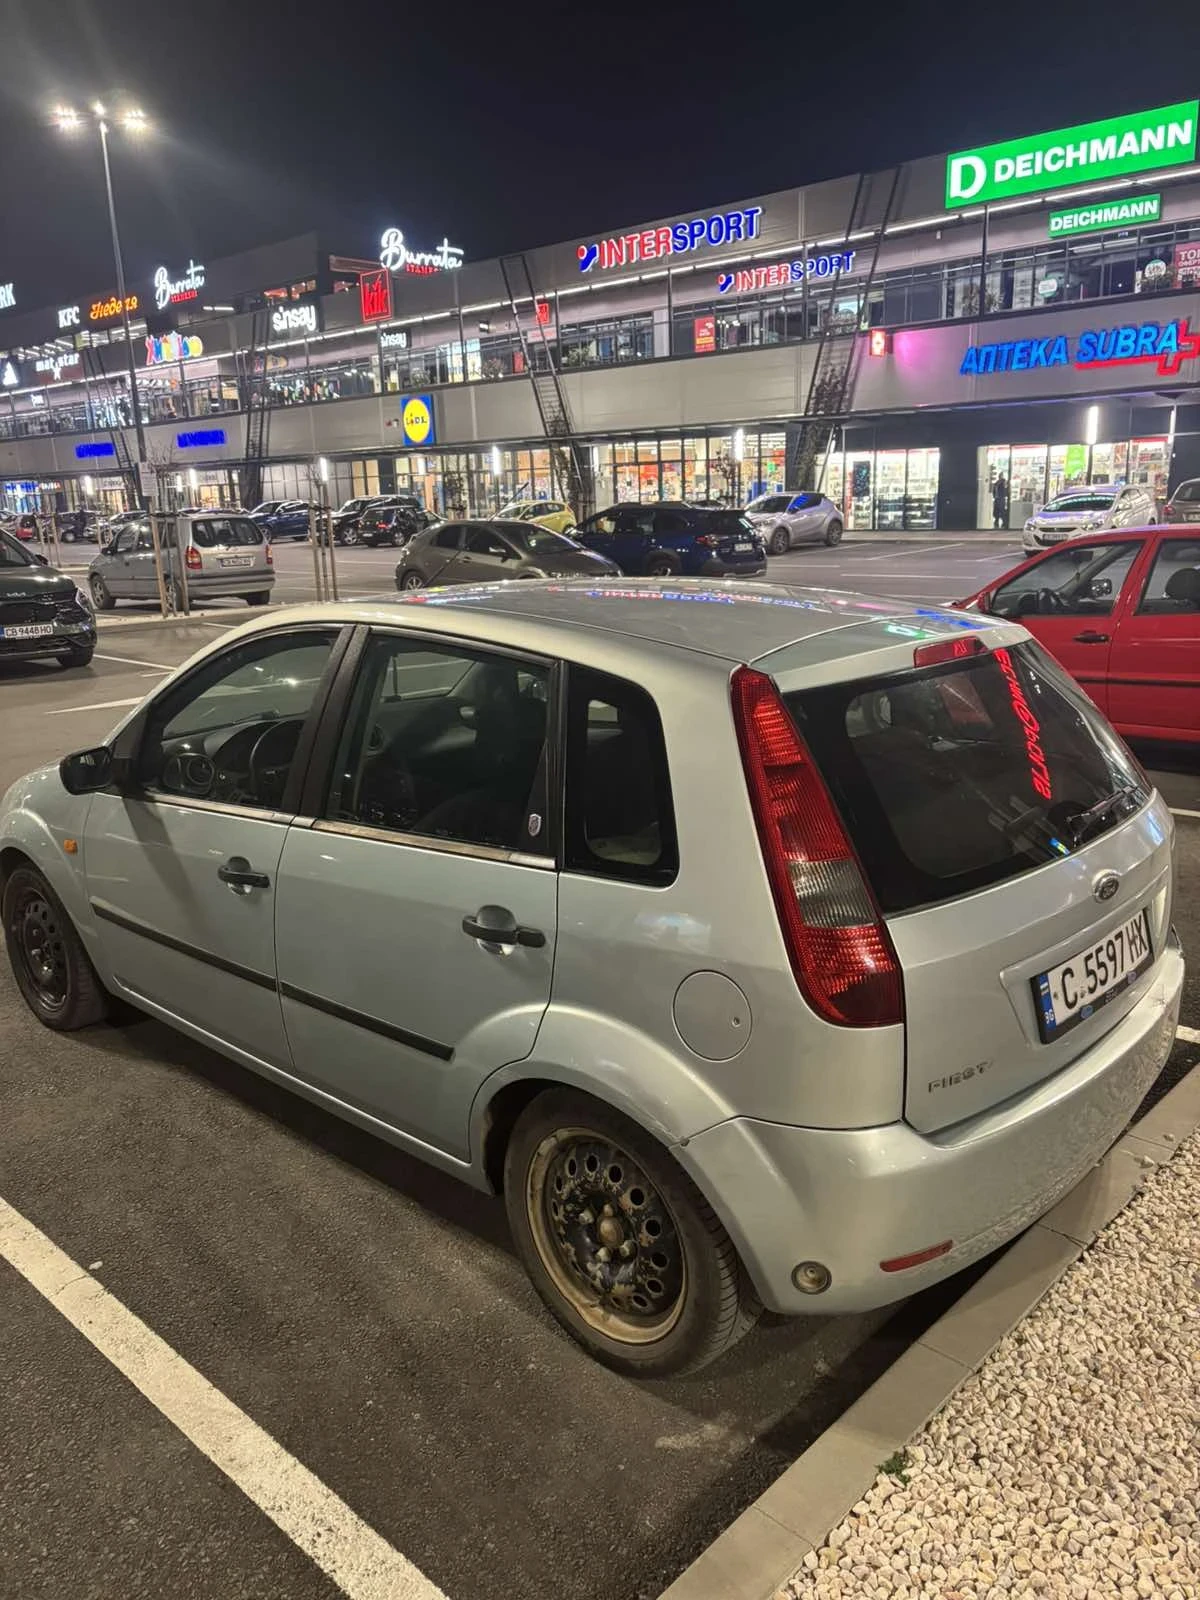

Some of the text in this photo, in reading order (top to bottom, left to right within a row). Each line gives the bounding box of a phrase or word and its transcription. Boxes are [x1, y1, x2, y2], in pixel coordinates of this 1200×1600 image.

[993, 119, 1193, 184] DEICHMANN
[1050, 199, 1158, 232] DEICHMANN
[380, 228, 464, 271] Burrata
[600, 206, 762, 269] INTERSPORT
[735, 252, 855, 292] INTERSPORT
[58, 306, 80, 328] KFC
[272, 305, 317, 331] sinsay
[959, 320, 1180, 376] АПТЕКА SUBRA
[1061, 914, 1148, 1009] C 5597 HX
